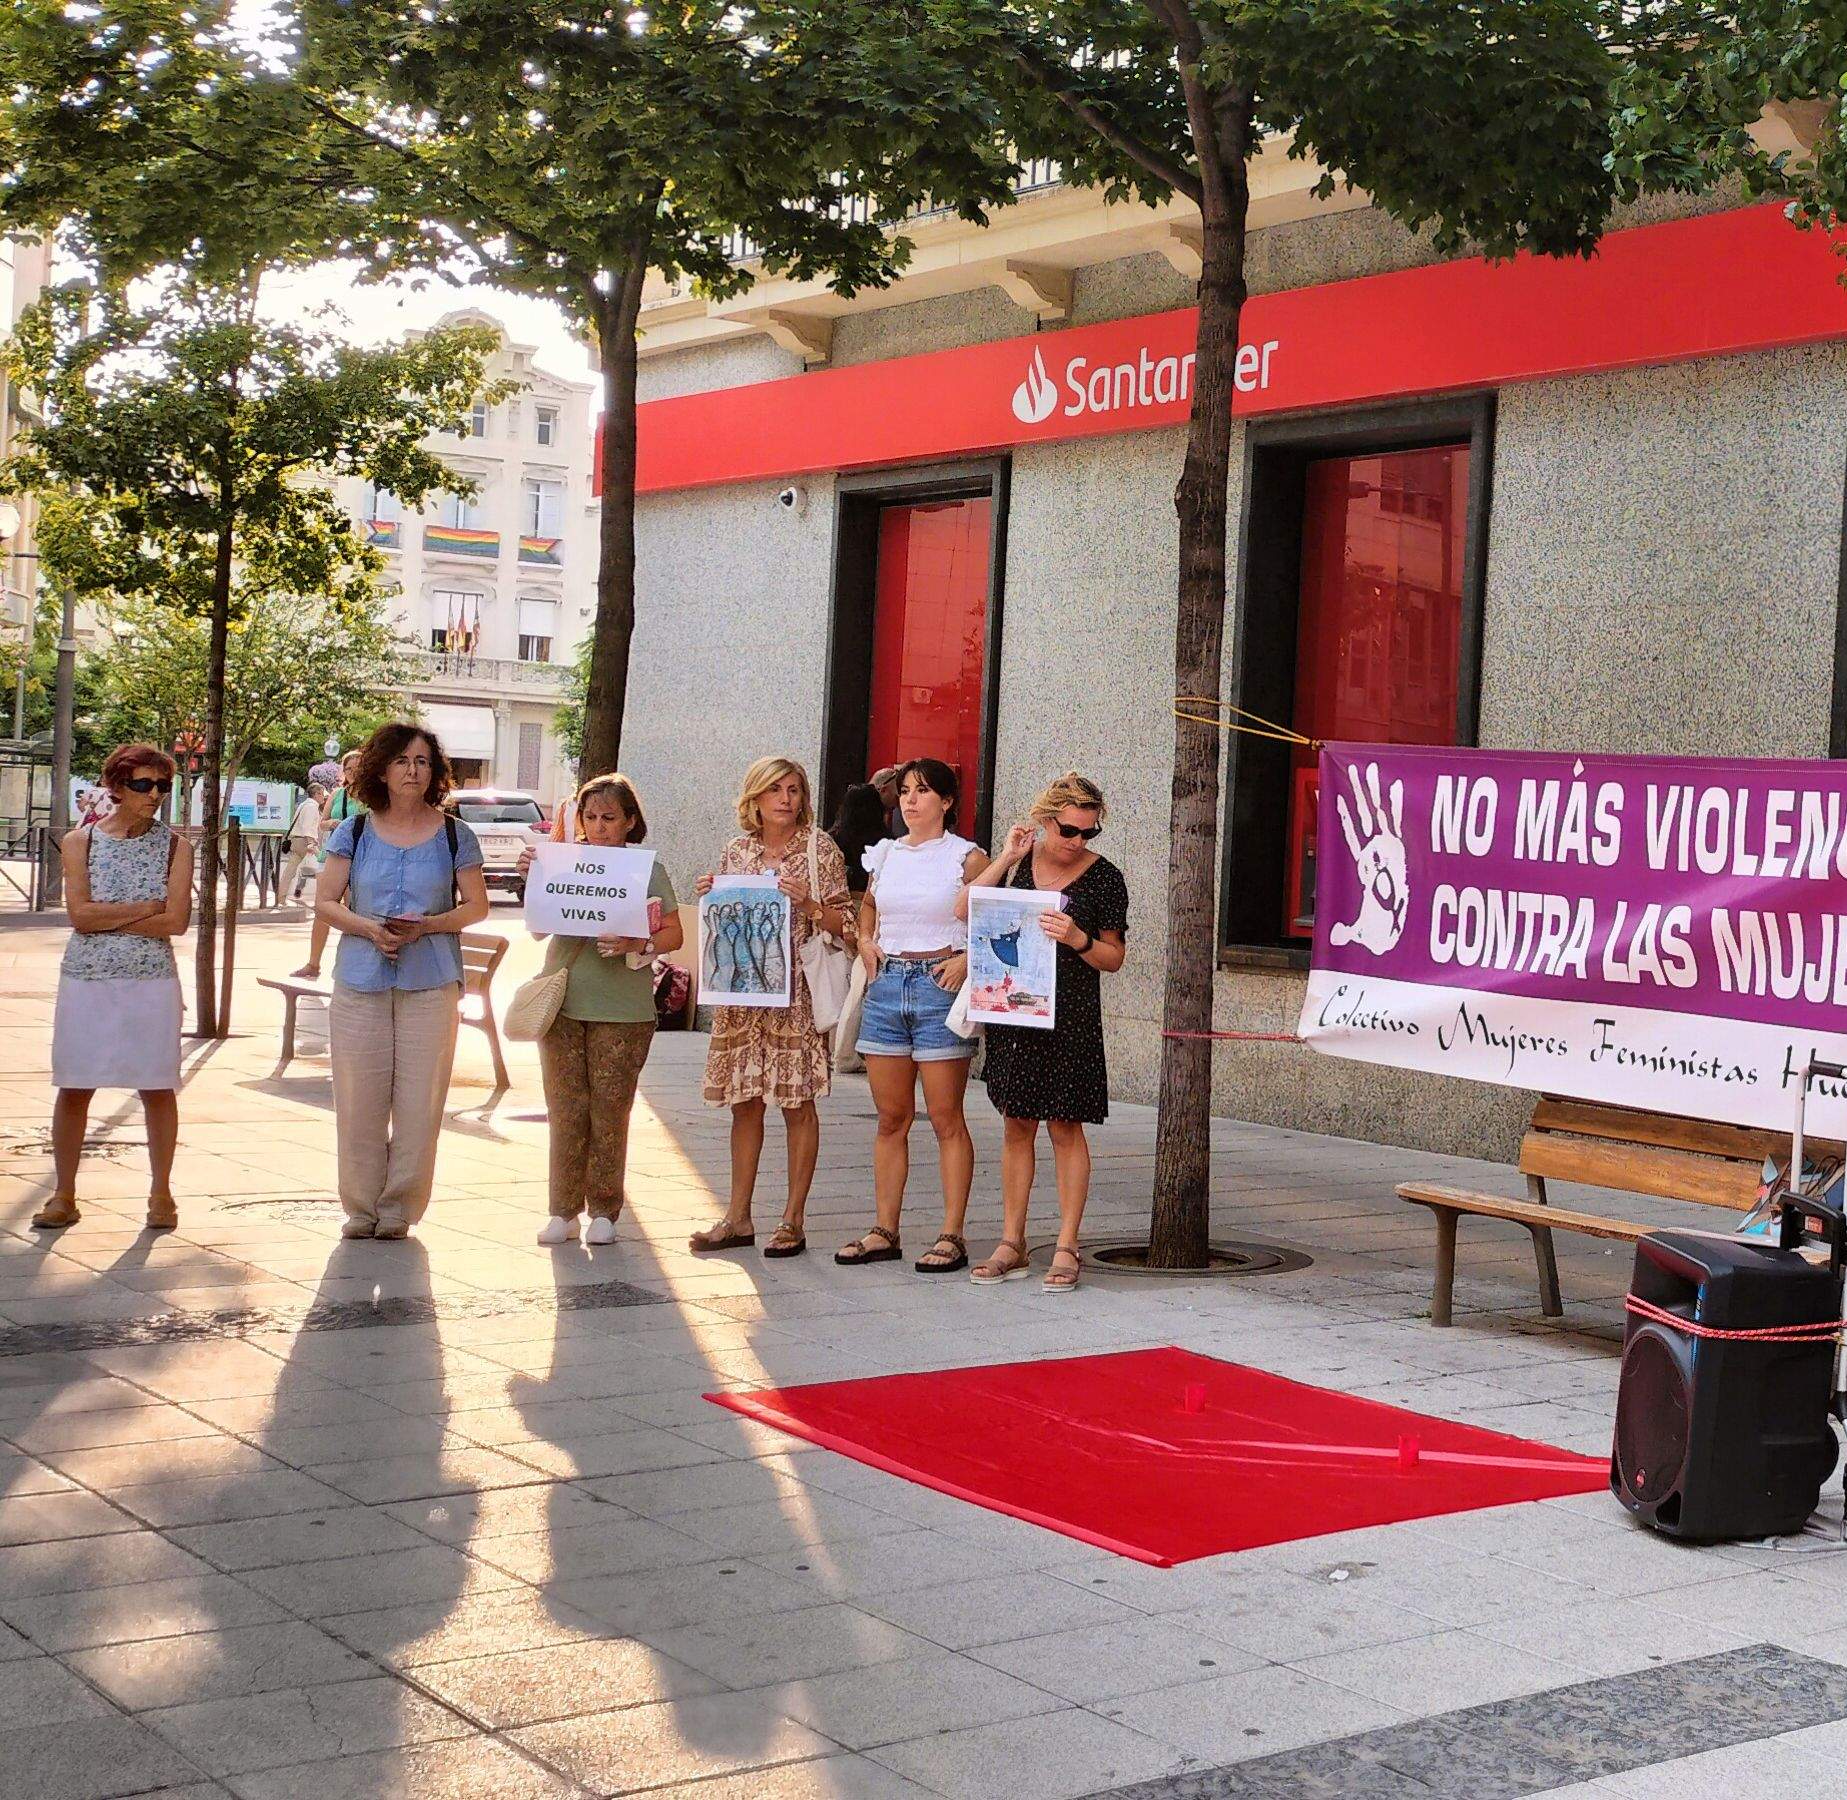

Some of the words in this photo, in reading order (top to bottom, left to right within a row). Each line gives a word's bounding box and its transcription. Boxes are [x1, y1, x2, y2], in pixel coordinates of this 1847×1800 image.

[1431, 774, 1499, 857] NO
[1513, 757, 1625, 867] MÁS
[545, 882, 628, 899] QUEREMOS
[574, 862, 606, 875] NOS
[561, 907, 606, 922] VIVAS
[1430, 883, 1595, 980] CONTRA
[1602, 900, 1698, 988] LAS
[1318, 984, 1420, 1035] Colectivo
[1437, 1000, 1568, 1079] Mujeres
[1589, 1018, 1758, 1086] Feministas
